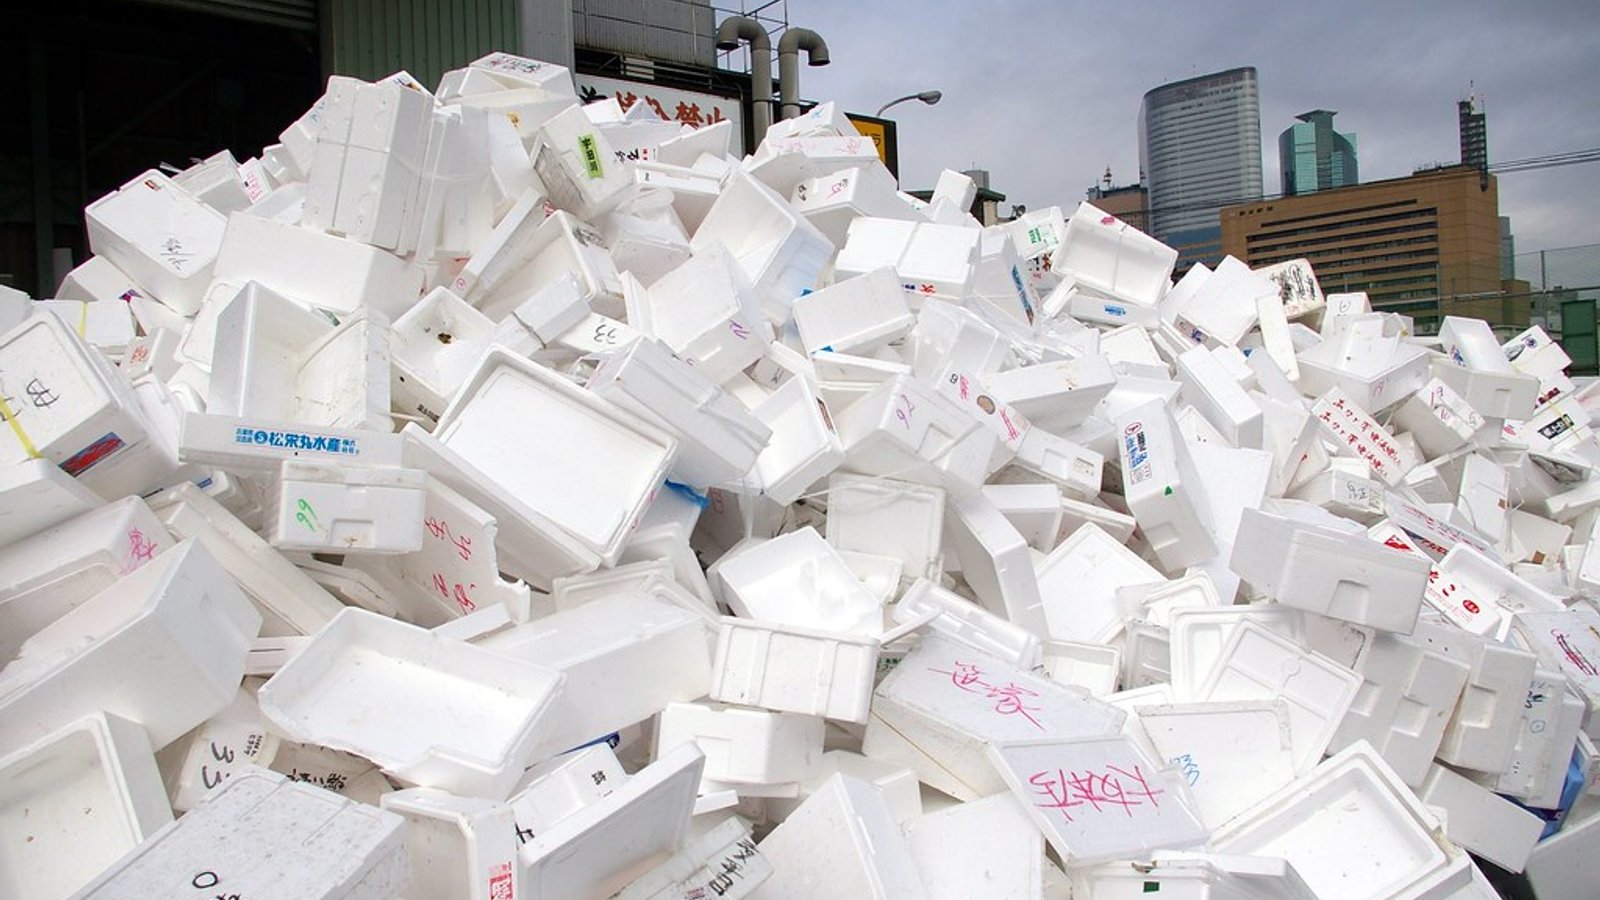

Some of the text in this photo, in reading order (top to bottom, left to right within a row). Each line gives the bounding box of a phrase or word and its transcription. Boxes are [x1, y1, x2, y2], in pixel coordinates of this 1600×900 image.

[269, 432, 342, 452] 松栄丸水産
